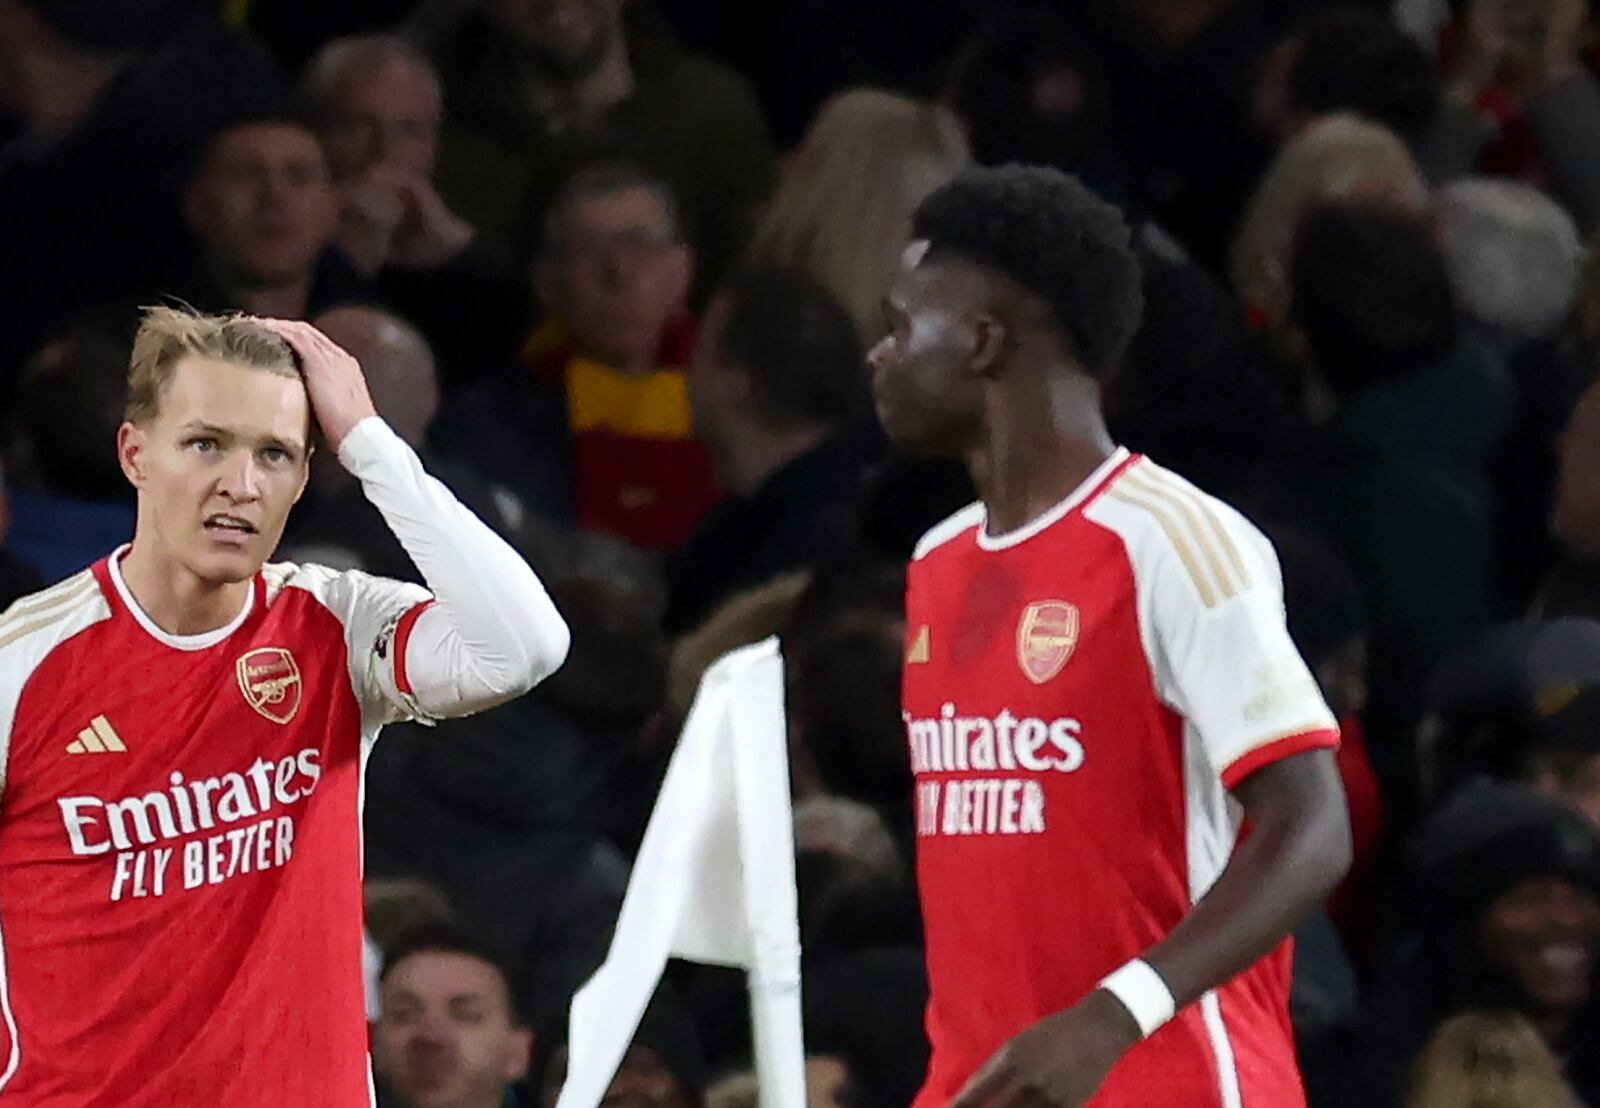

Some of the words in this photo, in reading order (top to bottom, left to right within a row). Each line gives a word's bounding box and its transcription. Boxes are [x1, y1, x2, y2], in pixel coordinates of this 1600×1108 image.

[902, 702, 1084, 775] mirates
[57, 748, 321, 856] Emirates
[942, 778, 1046, 836] BETTER
[110, 848, 173, 901] FLY
[183, 815, 294, 890] BETTER
